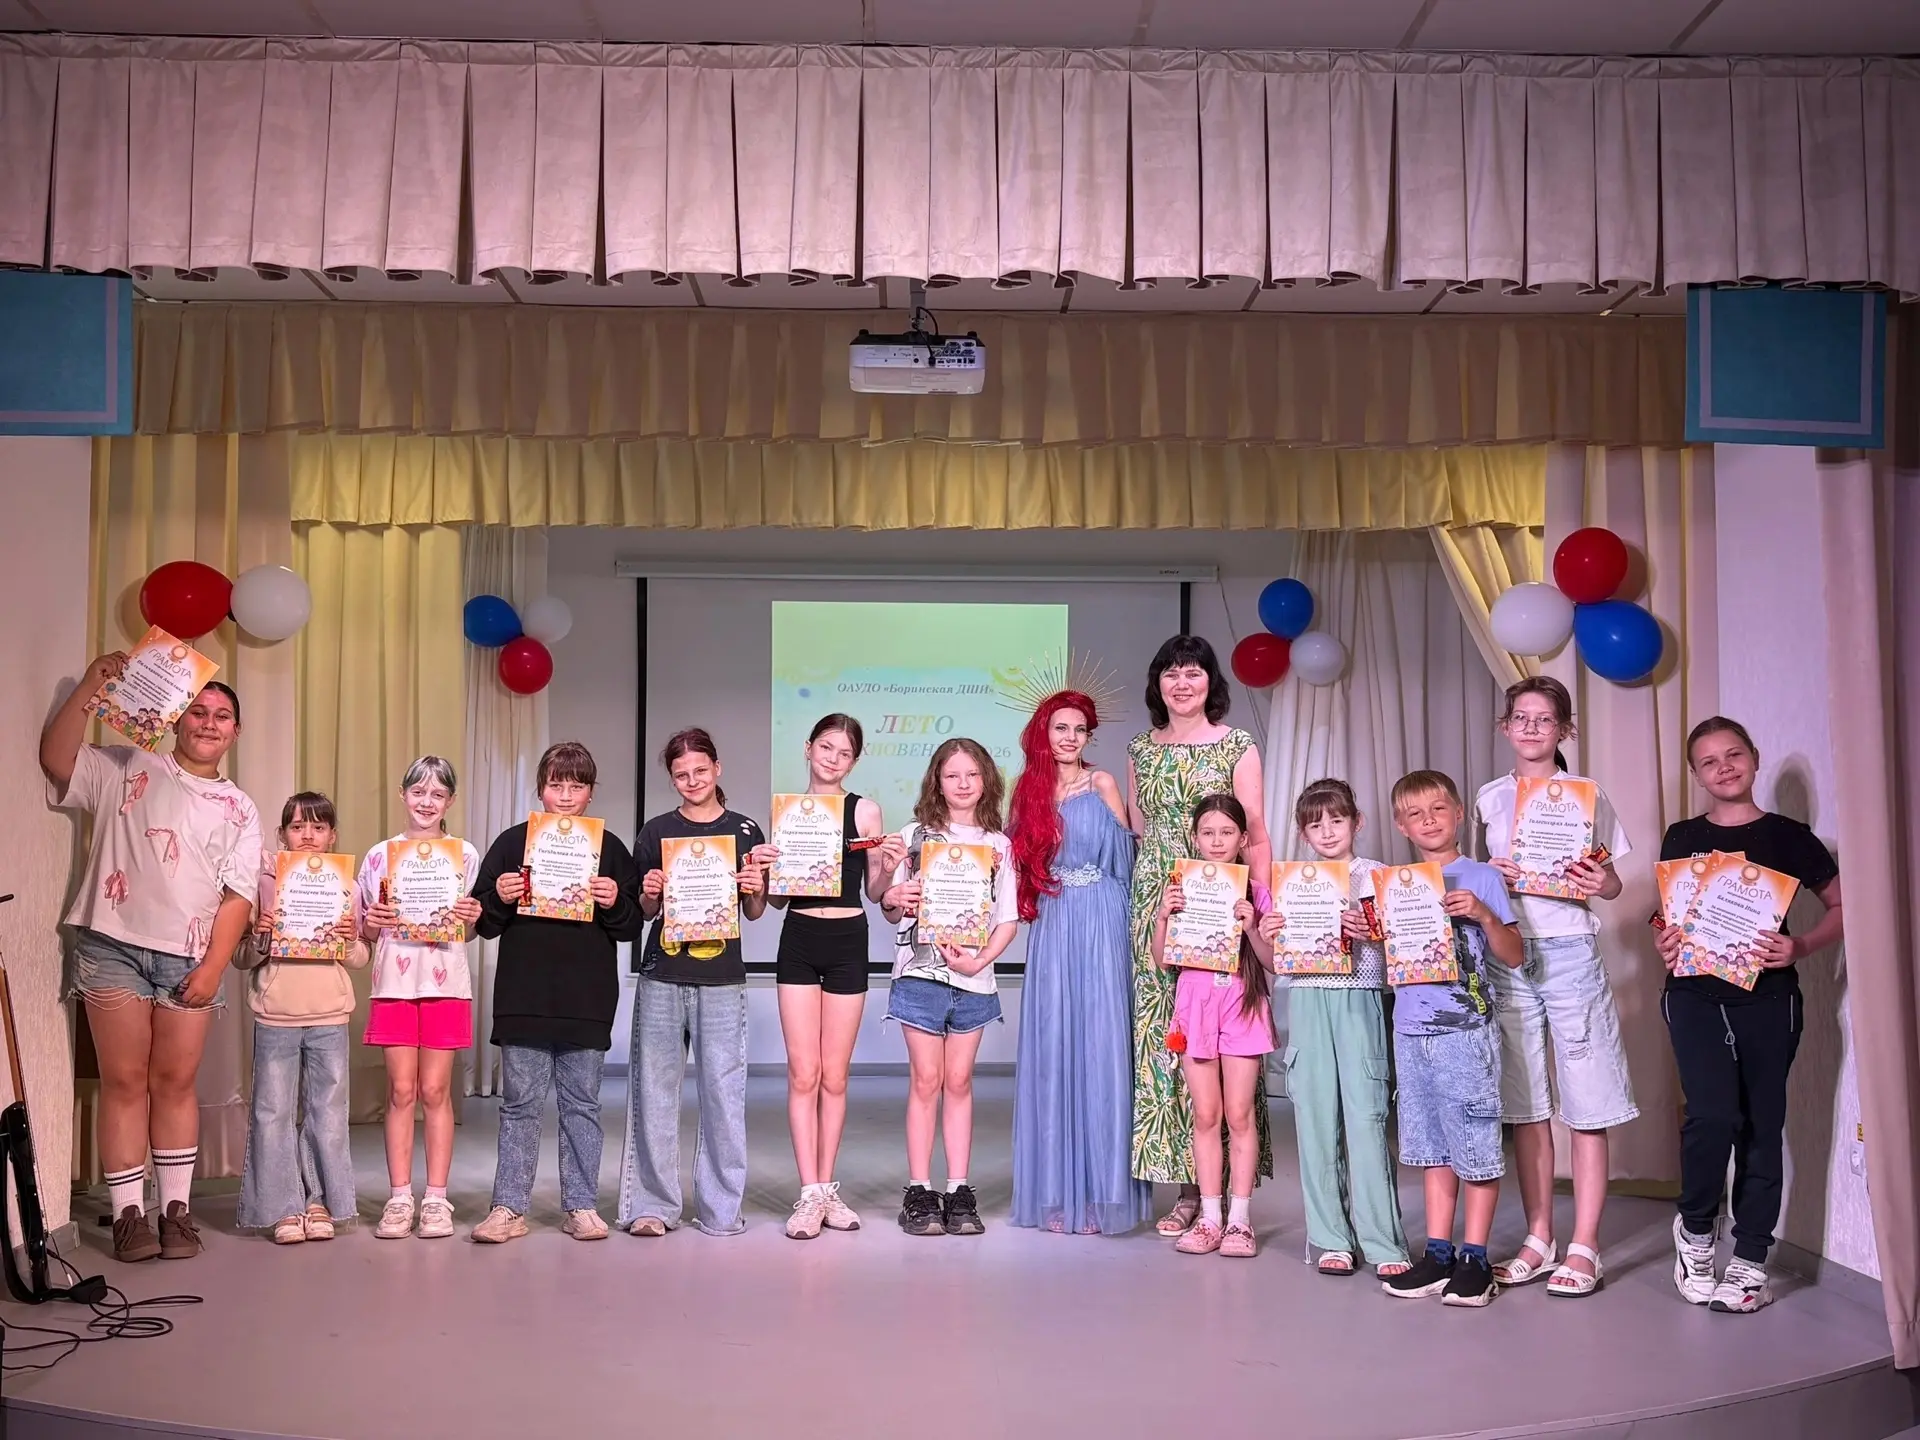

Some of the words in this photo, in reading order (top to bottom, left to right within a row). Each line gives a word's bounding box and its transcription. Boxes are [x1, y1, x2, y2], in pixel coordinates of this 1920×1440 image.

[148, 648, 192, 679] ГРАМОТА
[837, 682, 881, 694] ОАУДО
[883, 683, 953, 695] «Боринская
[875, 714, 954, 735] ЛЕТО
[1530, 799, 1579, 814] ГРАМОТА
[785, 813, 830, 824] ГРАМОТА
[540, 831, 588, 845] ГРАМОТА
[401, 857, 450, 869] ГРАМОТА
[676, 855, 722, 868] ГРАМОТА
[933, 861, 978, 873] ГРАМОТА
[290, 871, 339, 883] ГРАМОТА
[1185, 878, 1232, 892] ГРАМОТА
[1286, 881, 1334, 893] ГРАМОТА
[1388, 883, 1431, 899] ГРАМОТА
[1717, 875, 1773, 900] ГРАМОТА
